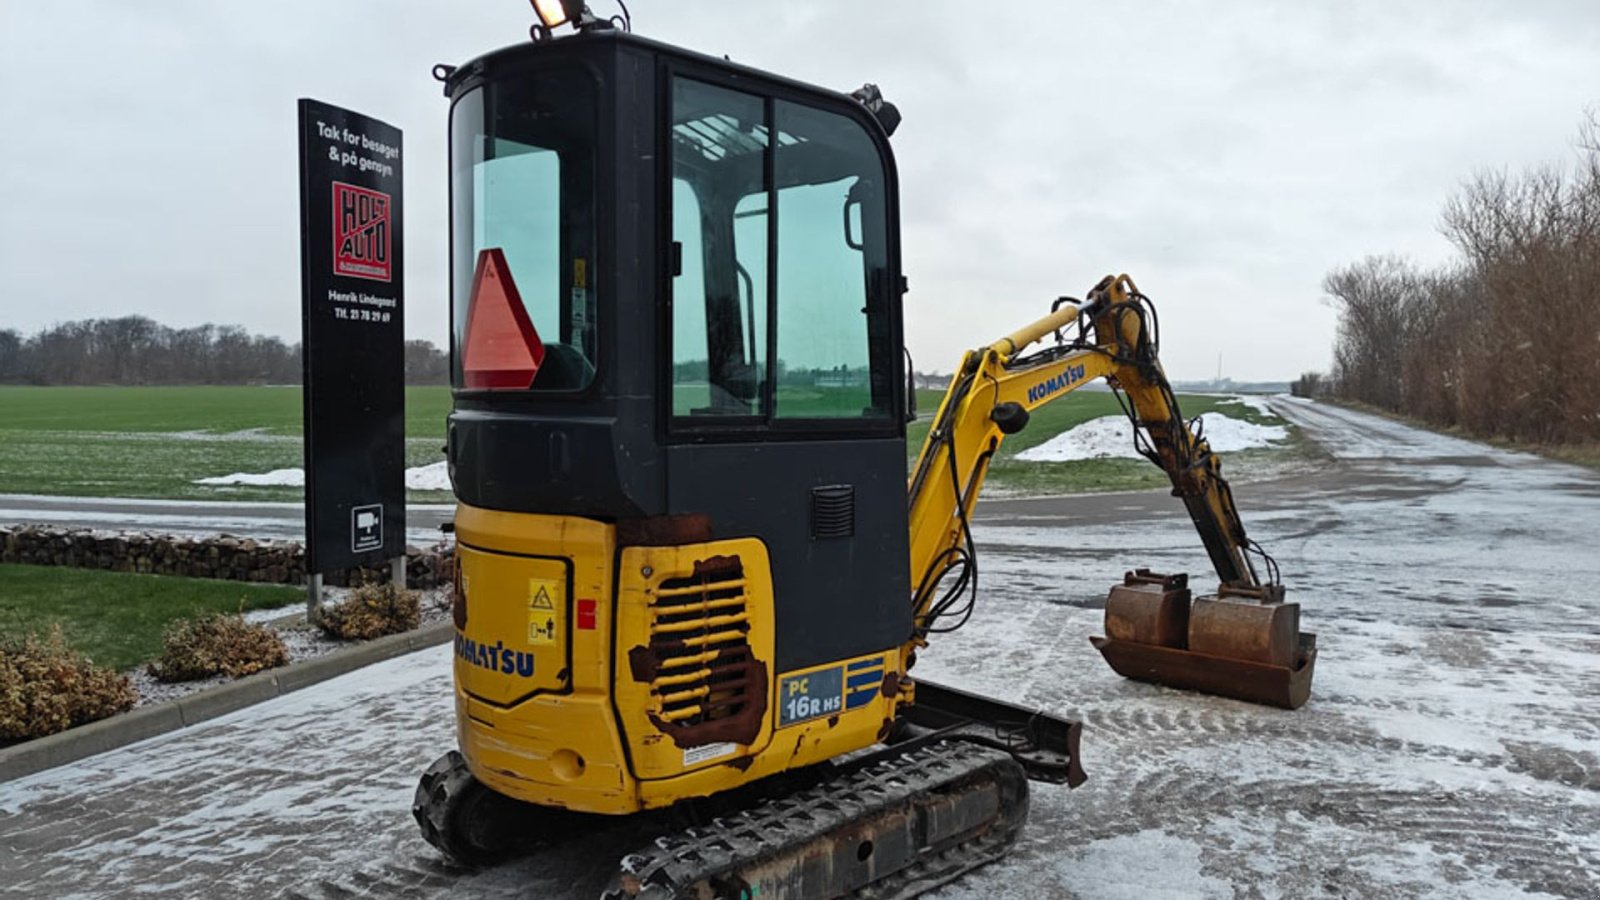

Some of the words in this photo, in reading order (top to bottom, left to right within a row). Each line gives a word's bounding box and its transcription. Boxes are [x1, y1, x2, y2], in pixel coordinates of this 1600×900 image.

[317, 121, 340, 140] Tak
[343, 128, 360, 146] for
[362, 134, 399, 158] besøget
[329, 145, 340, 162] &
[342, 151, 358, 167] på
[359, 157, 393, 177] gensyn
[342, 190, 385, 234] HOLT
[340, 221, 386, 262] AUTO
[328, 290, 358, 303] Henrik
[1028, 364, 1084, 403] KOMATSU
[789, 678, 809, 696] PC
[824, 696, 841, 711] HS
